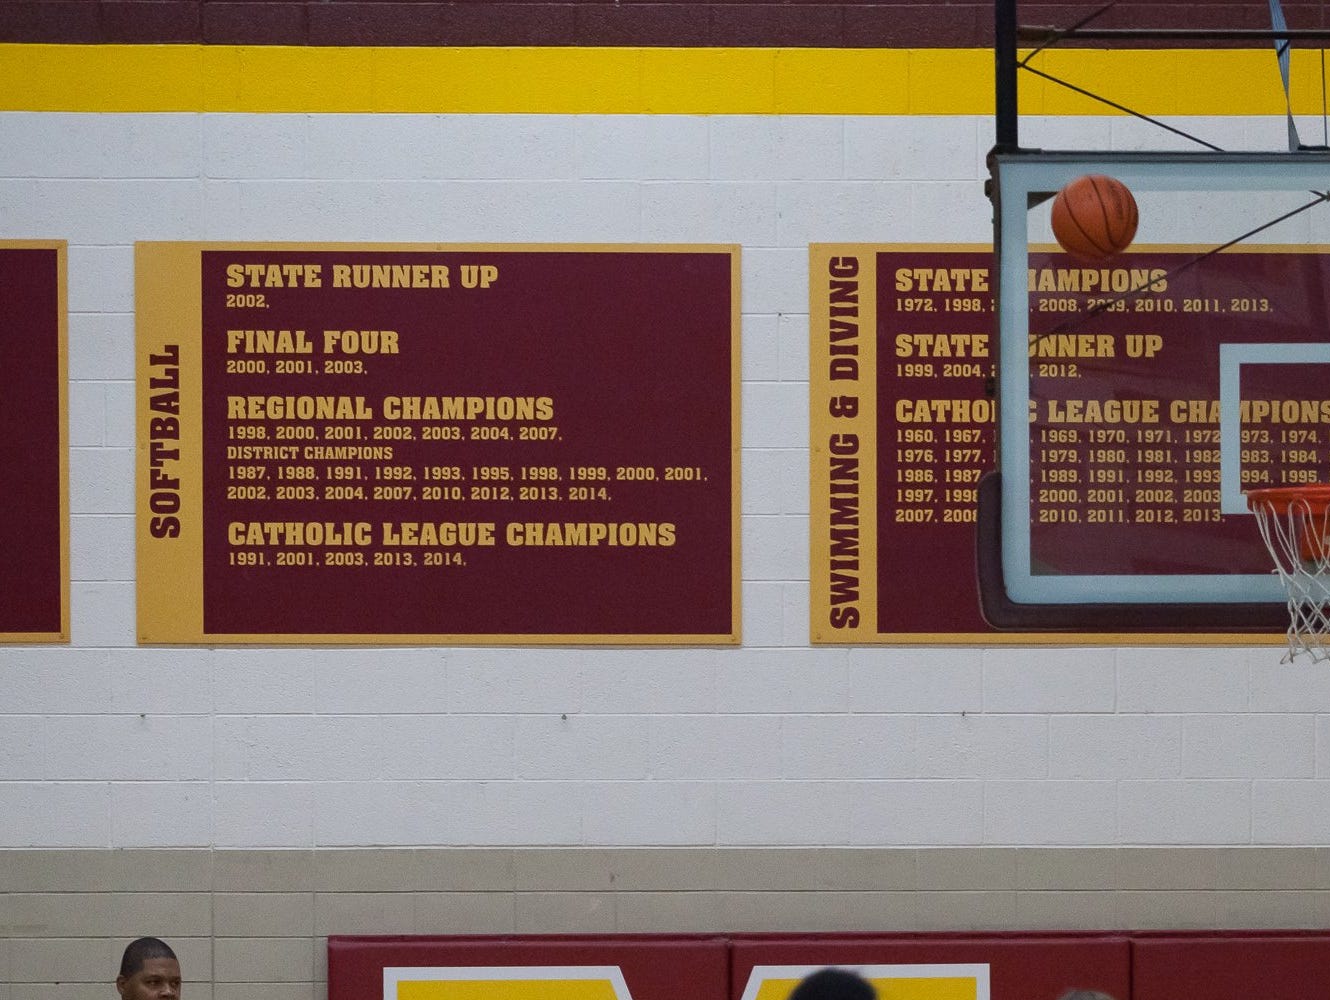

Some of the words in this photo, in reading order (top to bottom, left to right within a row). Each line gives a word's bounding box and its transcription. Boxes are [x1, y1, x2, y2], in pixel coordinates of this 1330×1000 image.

[226, 263, 322, 289] STATE
[332, 263, 450, 289] RUNNER
[459, 263, 499, 289] UP
[895, 268, 989, 293] STATE
[1028, 268, 1168, 293] AMPIONS
[828, 256, 860, 381] DIVING
[226, 330, 313, 355] FINAL
[323, 330, 400, 355] FOUR
[895, 333, 989, 358] STATE
[1125, 333, 1163, 358] UP
[227, 395, 373, 421] REGIONAL
[383, 395, 554, 421] CHAMPIONS
[828, 395, 860, 419] &
[1047, 399, 1160, 424] LEAGUE
[149, 344, 181, 539] SOFTBALL
[227, 446, 300, 460] DISTRICT
[304, 446, 393, 460] CHAMPIONS
[228, 521, 372, 547] CATHOLIC
[382, 521, 496, 547] LEAGUE
[506, 521, 676, 547] CHAMPIONS
[828, 433, 860, 630] SWIMMING
